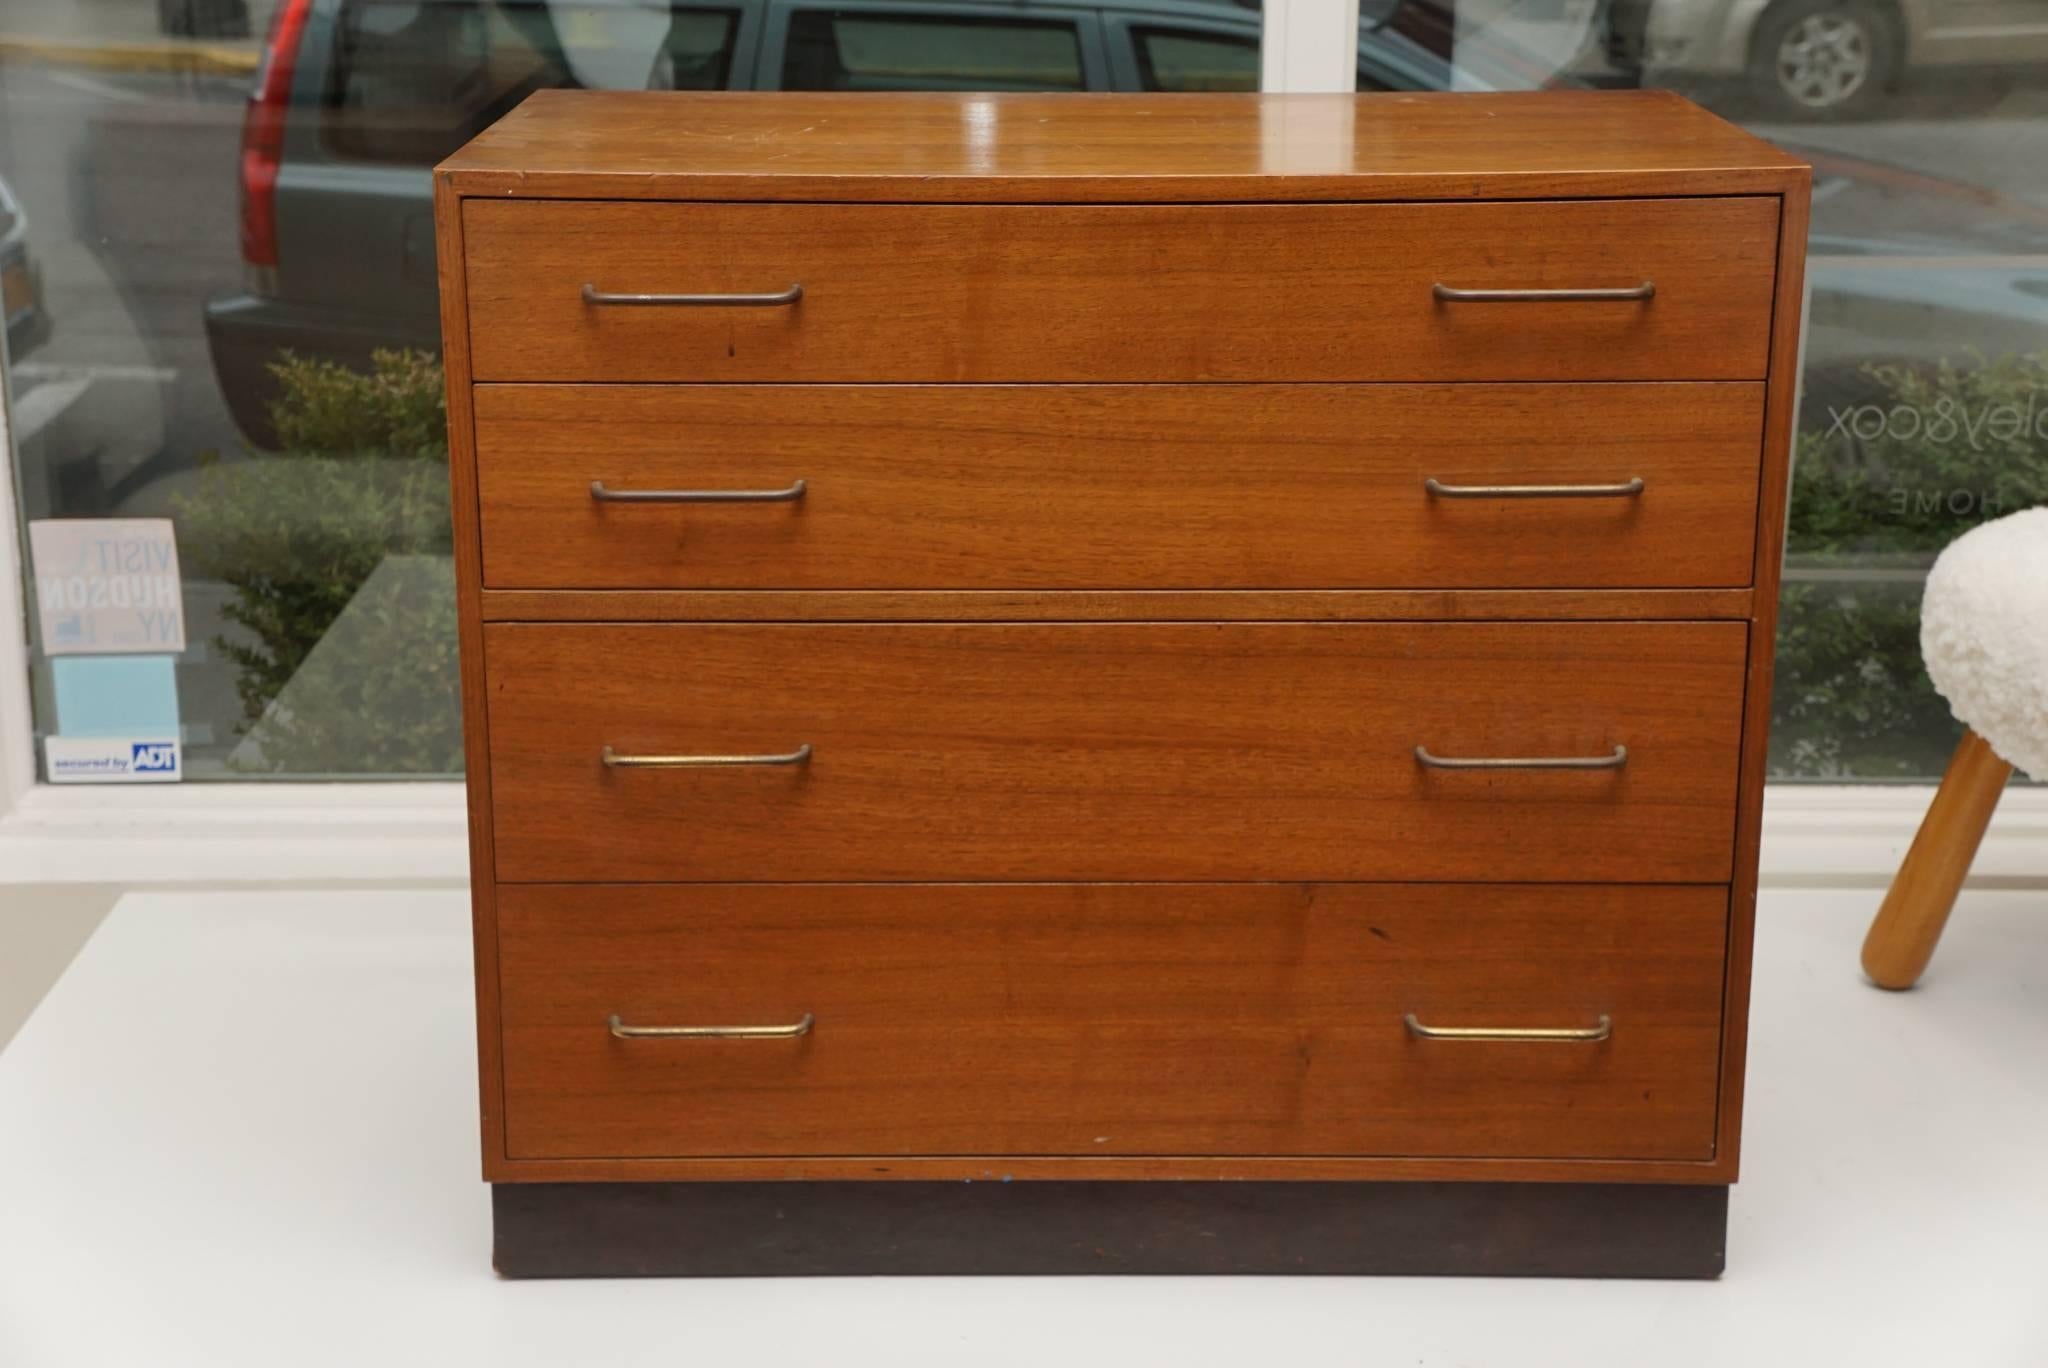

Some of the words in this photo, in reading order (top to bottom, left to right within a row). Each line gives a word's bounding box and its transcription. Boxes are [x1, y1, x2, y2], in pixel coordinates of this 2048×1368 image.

[54, 756, 110, 768] secured
[113, 756, 129, 771] by
[134, 746, 175, 769] ADT
